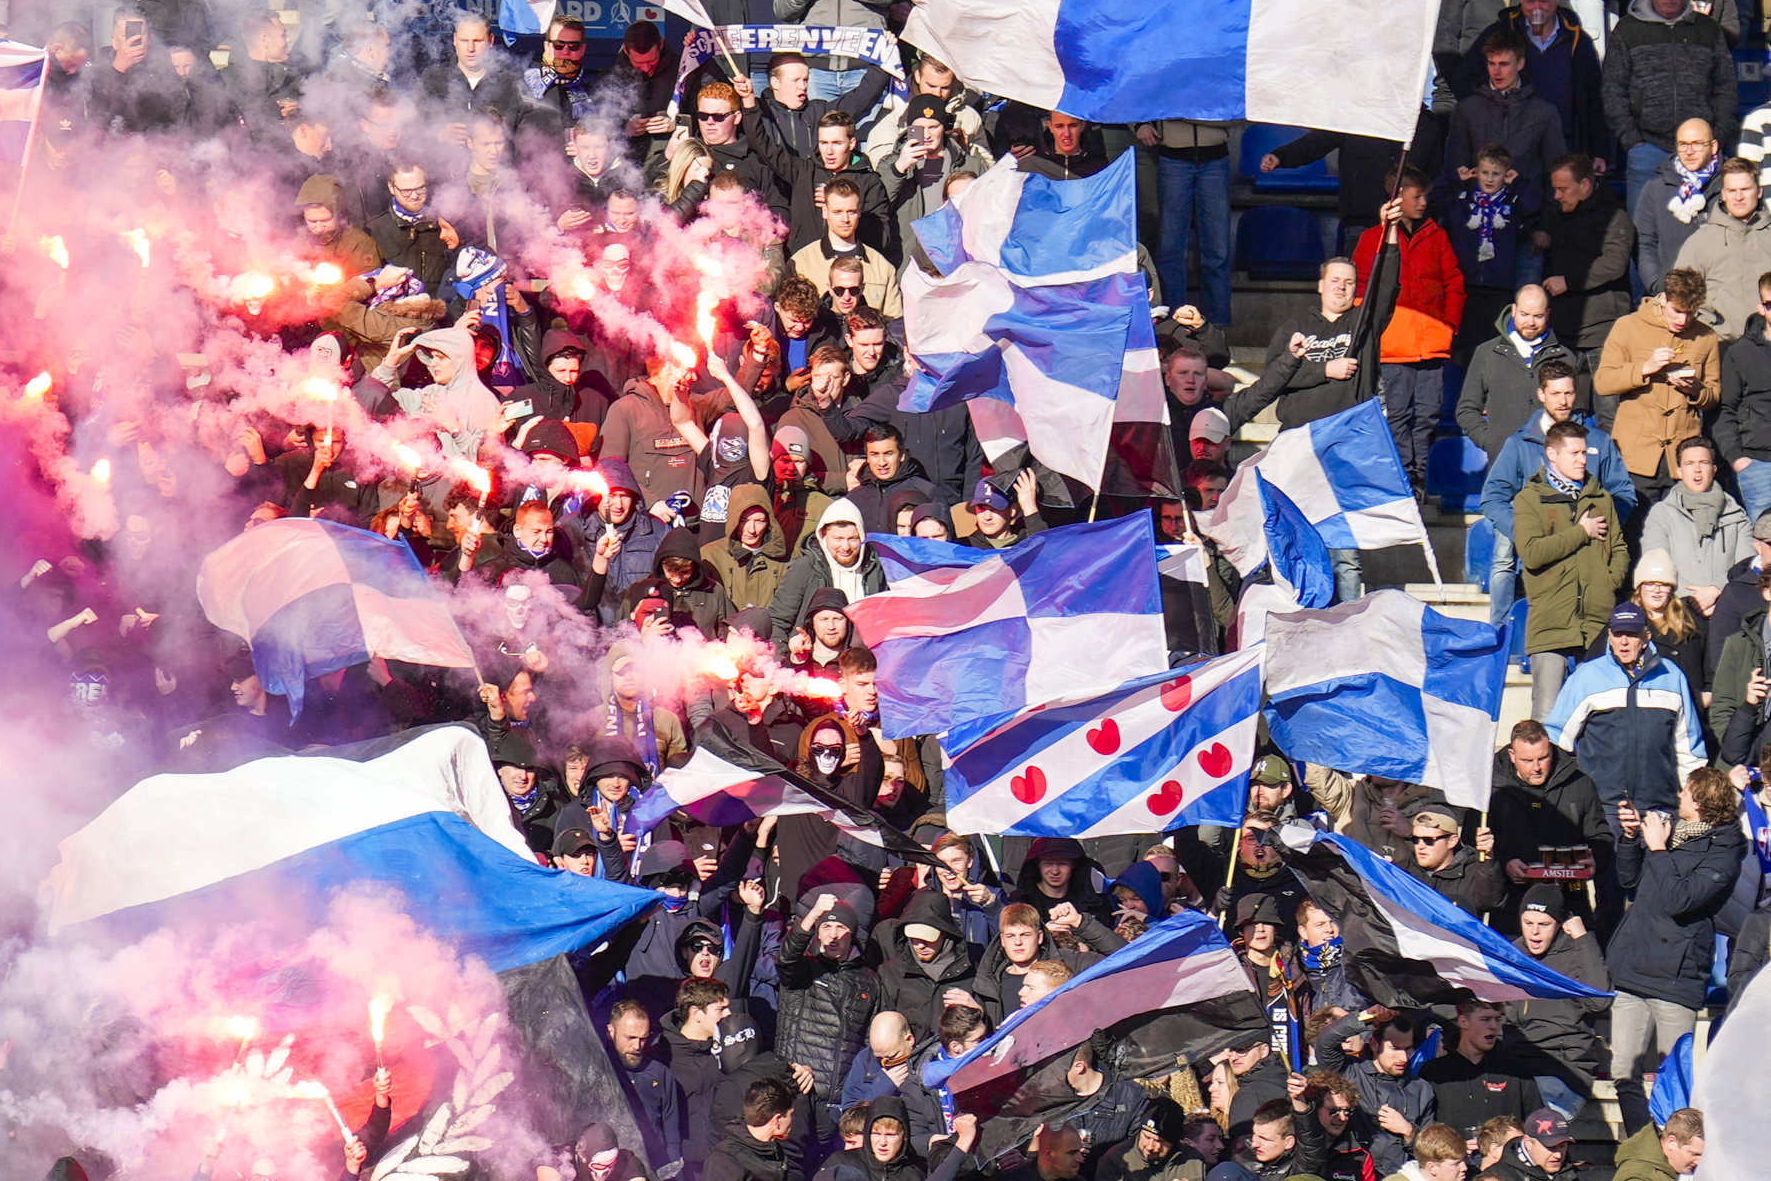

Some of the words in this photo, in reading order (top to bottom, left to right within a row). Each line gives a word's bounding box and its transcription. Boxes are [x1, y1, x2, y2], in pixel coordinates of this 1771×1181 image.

[552, 0, 602, 22] ARD
[699, 27, 893, 65] HEERENVEEN
[1542, 869, 1576, 878] AMSTEL
